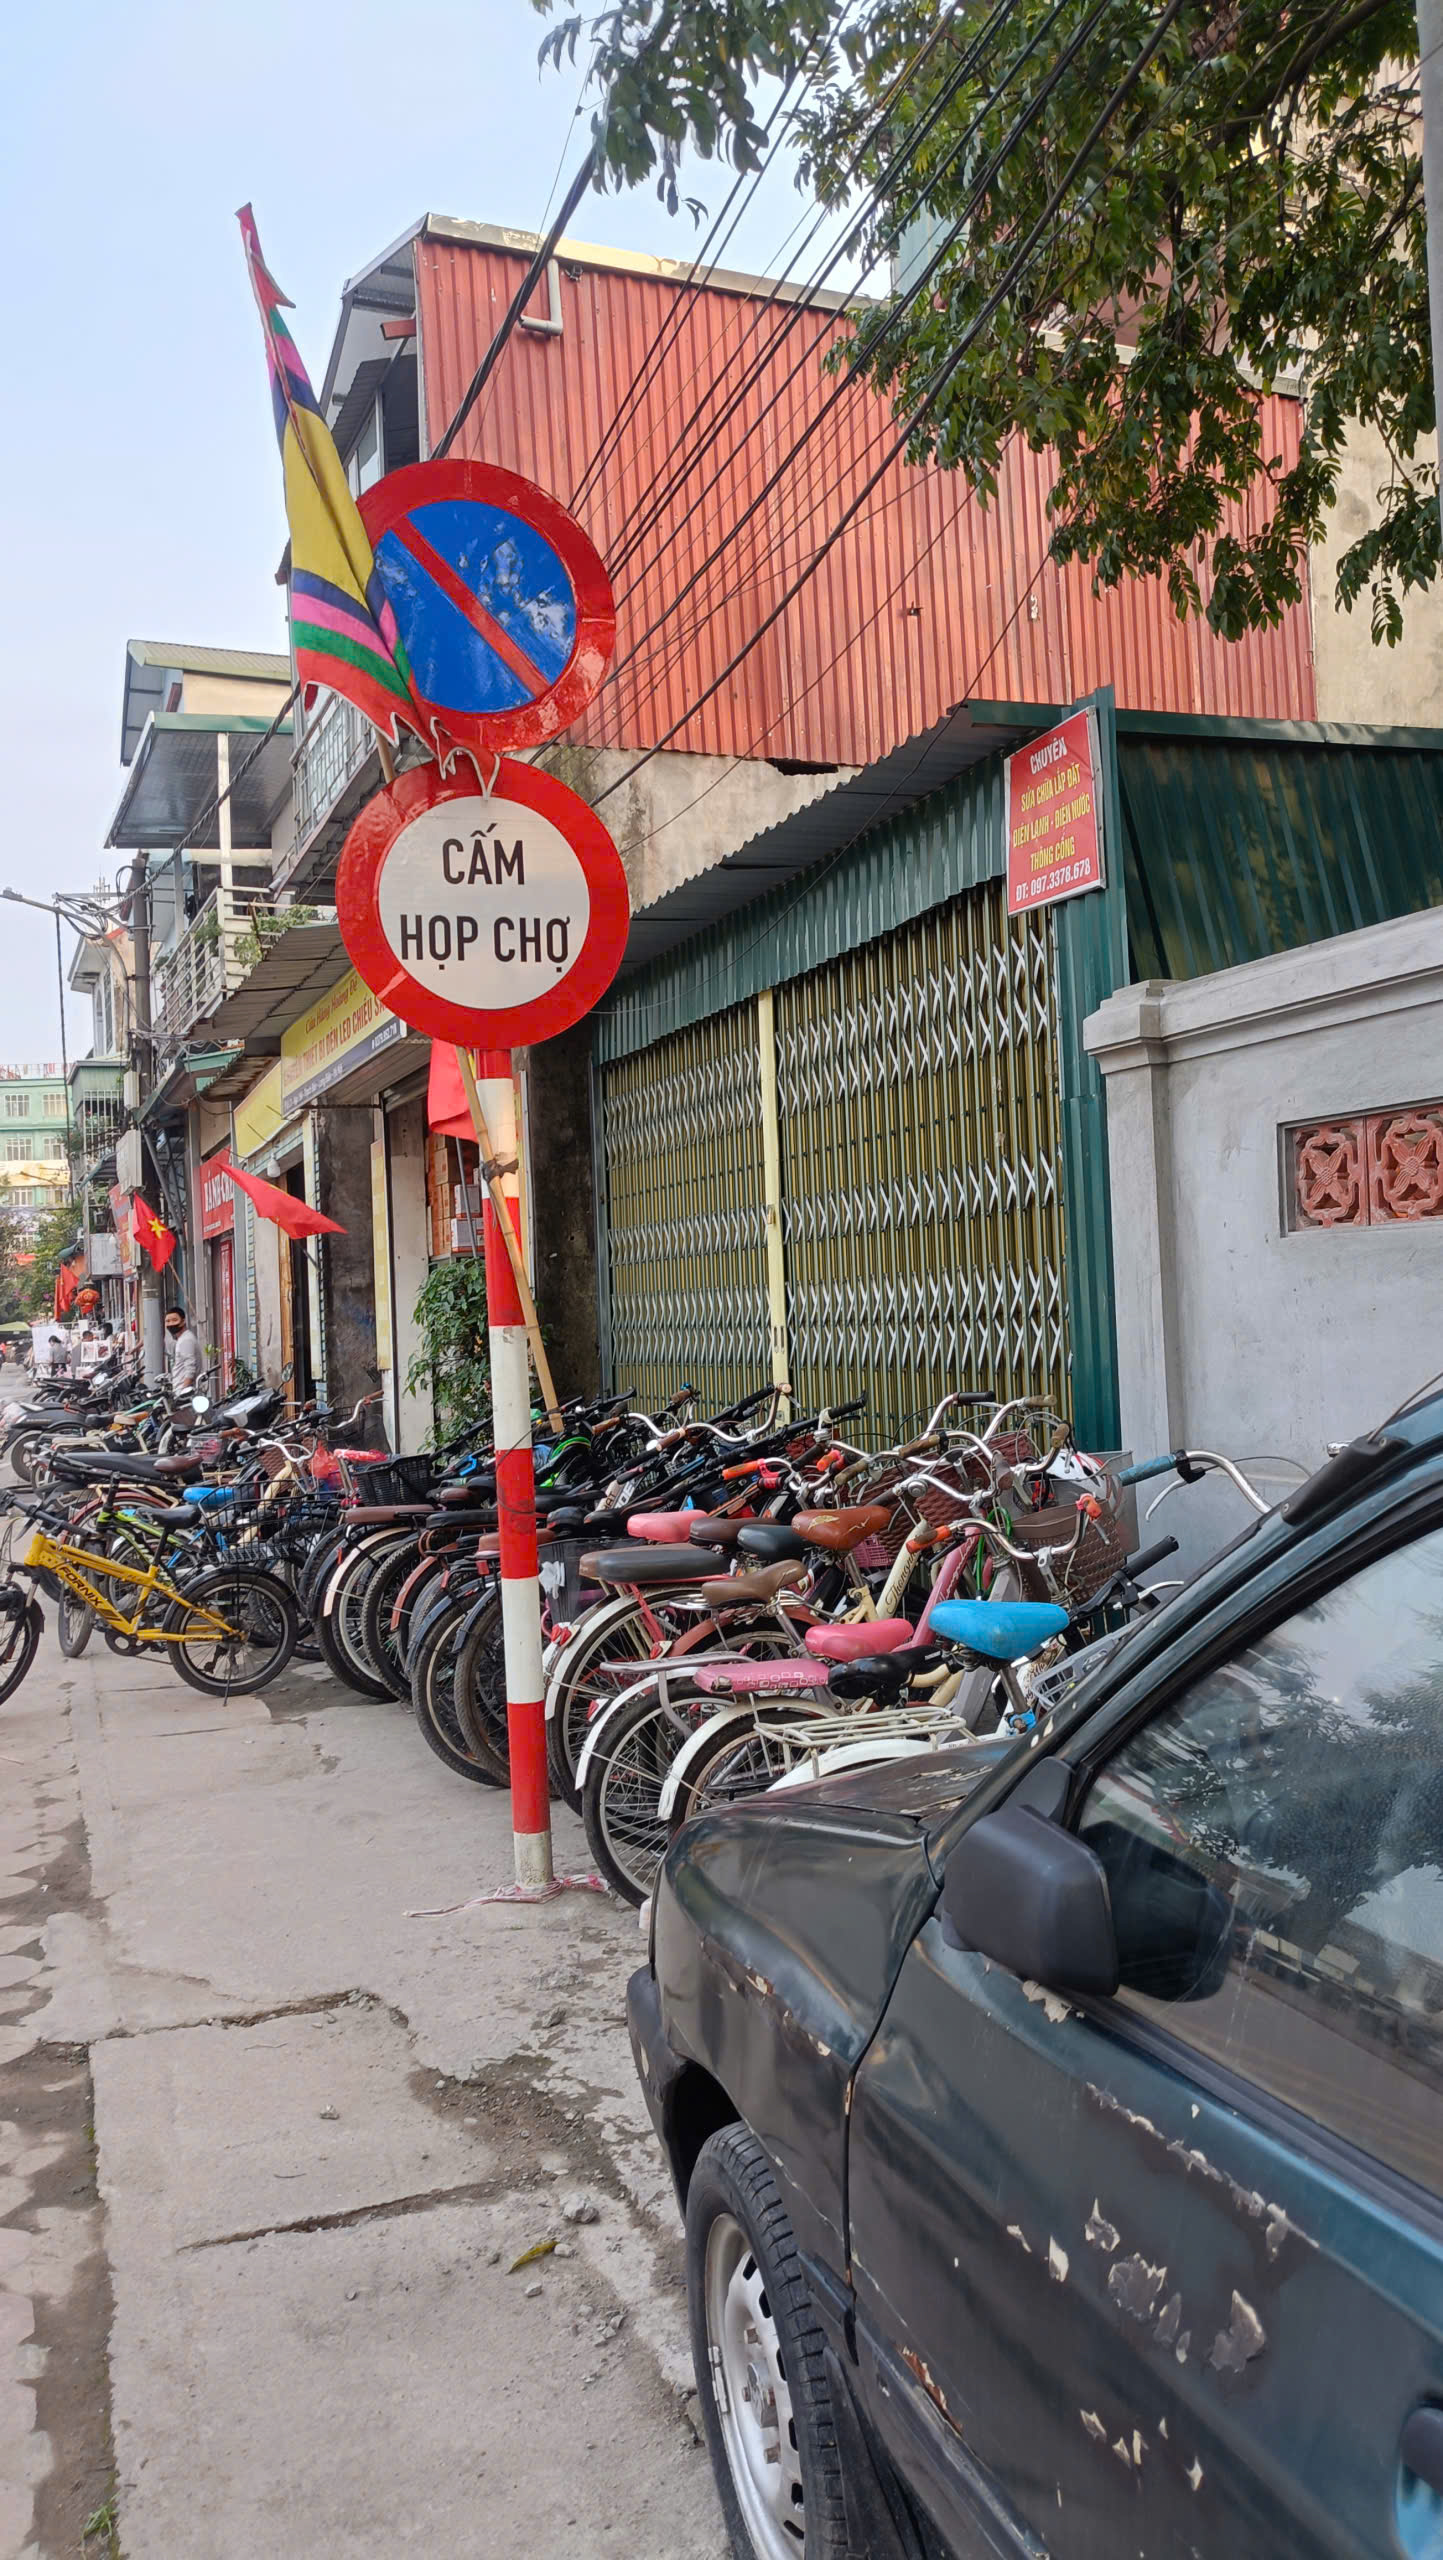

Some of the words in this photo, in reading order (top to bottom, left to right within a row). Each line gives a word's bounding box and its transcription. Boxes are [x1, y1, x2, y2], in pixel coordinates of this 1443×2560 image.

[1030, 736, 1068, 774] CHUYÊN
[1021, 785, 1036, 812] SỬA
[1037, 777, 1054, 805] CHỮA
[1054, 767, 1066, 796] LẮP
[1067, 762, 1080, 790] ĐẶT
[1013, 822, 1030, 849] ĐIỆN
[1031, 815, 1050, 842] LẠNH
[1055, 802, 1072, 830] ĐIỆN
[1071, 791, 1091, 821] NƯỚC
[441, 822, 526, 886] CẤM
[1030, 845, 1054, 873] THÔNG
[1055, 832, 1076, 863] CỐNG
[1030, 857, 1091, 896] 097.3378.678
[399, 914, 479, 971] HỌP
[493, 915, 571, 973] CHỢ
[339, 1015, 351, 1046] LED
[58, 1566, 103, 1606] FORNIX
